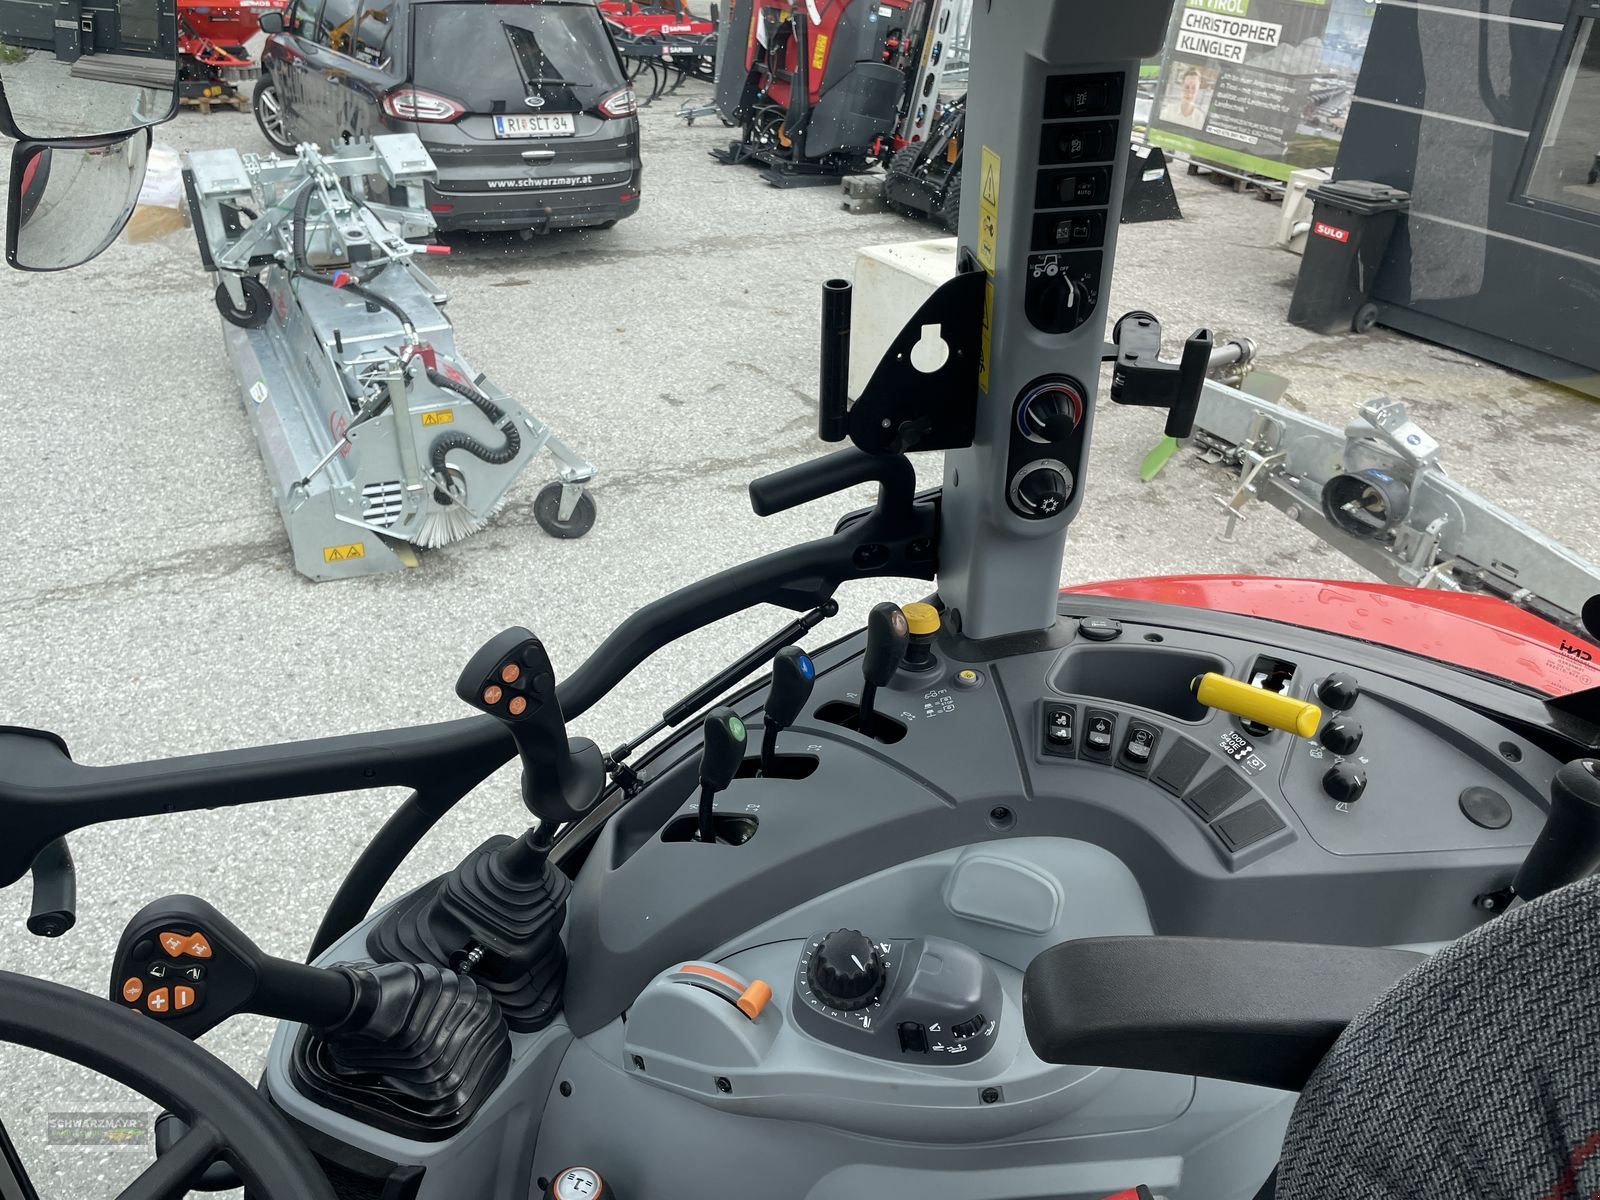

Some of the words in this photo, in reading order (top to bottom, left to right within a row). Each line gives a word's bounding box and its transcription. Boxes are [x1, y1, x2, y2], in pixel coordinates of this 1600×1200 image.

[1185, 13, 1277, 44] CHRISTOPHER
[1180, 34, 1243, 61] KLINGLER
[507, 117, 520, 132] RI
[553, 116, 568, 130] 34
[487, 175, 593, 188] www.schwarzmayr.at
[1317, 224, 1344, 239] SULO
[1220, 733, 1241, 751] 540E
[1228, 731, 1247, 746] 1000
[1219, 741, 1235, 754] 540
